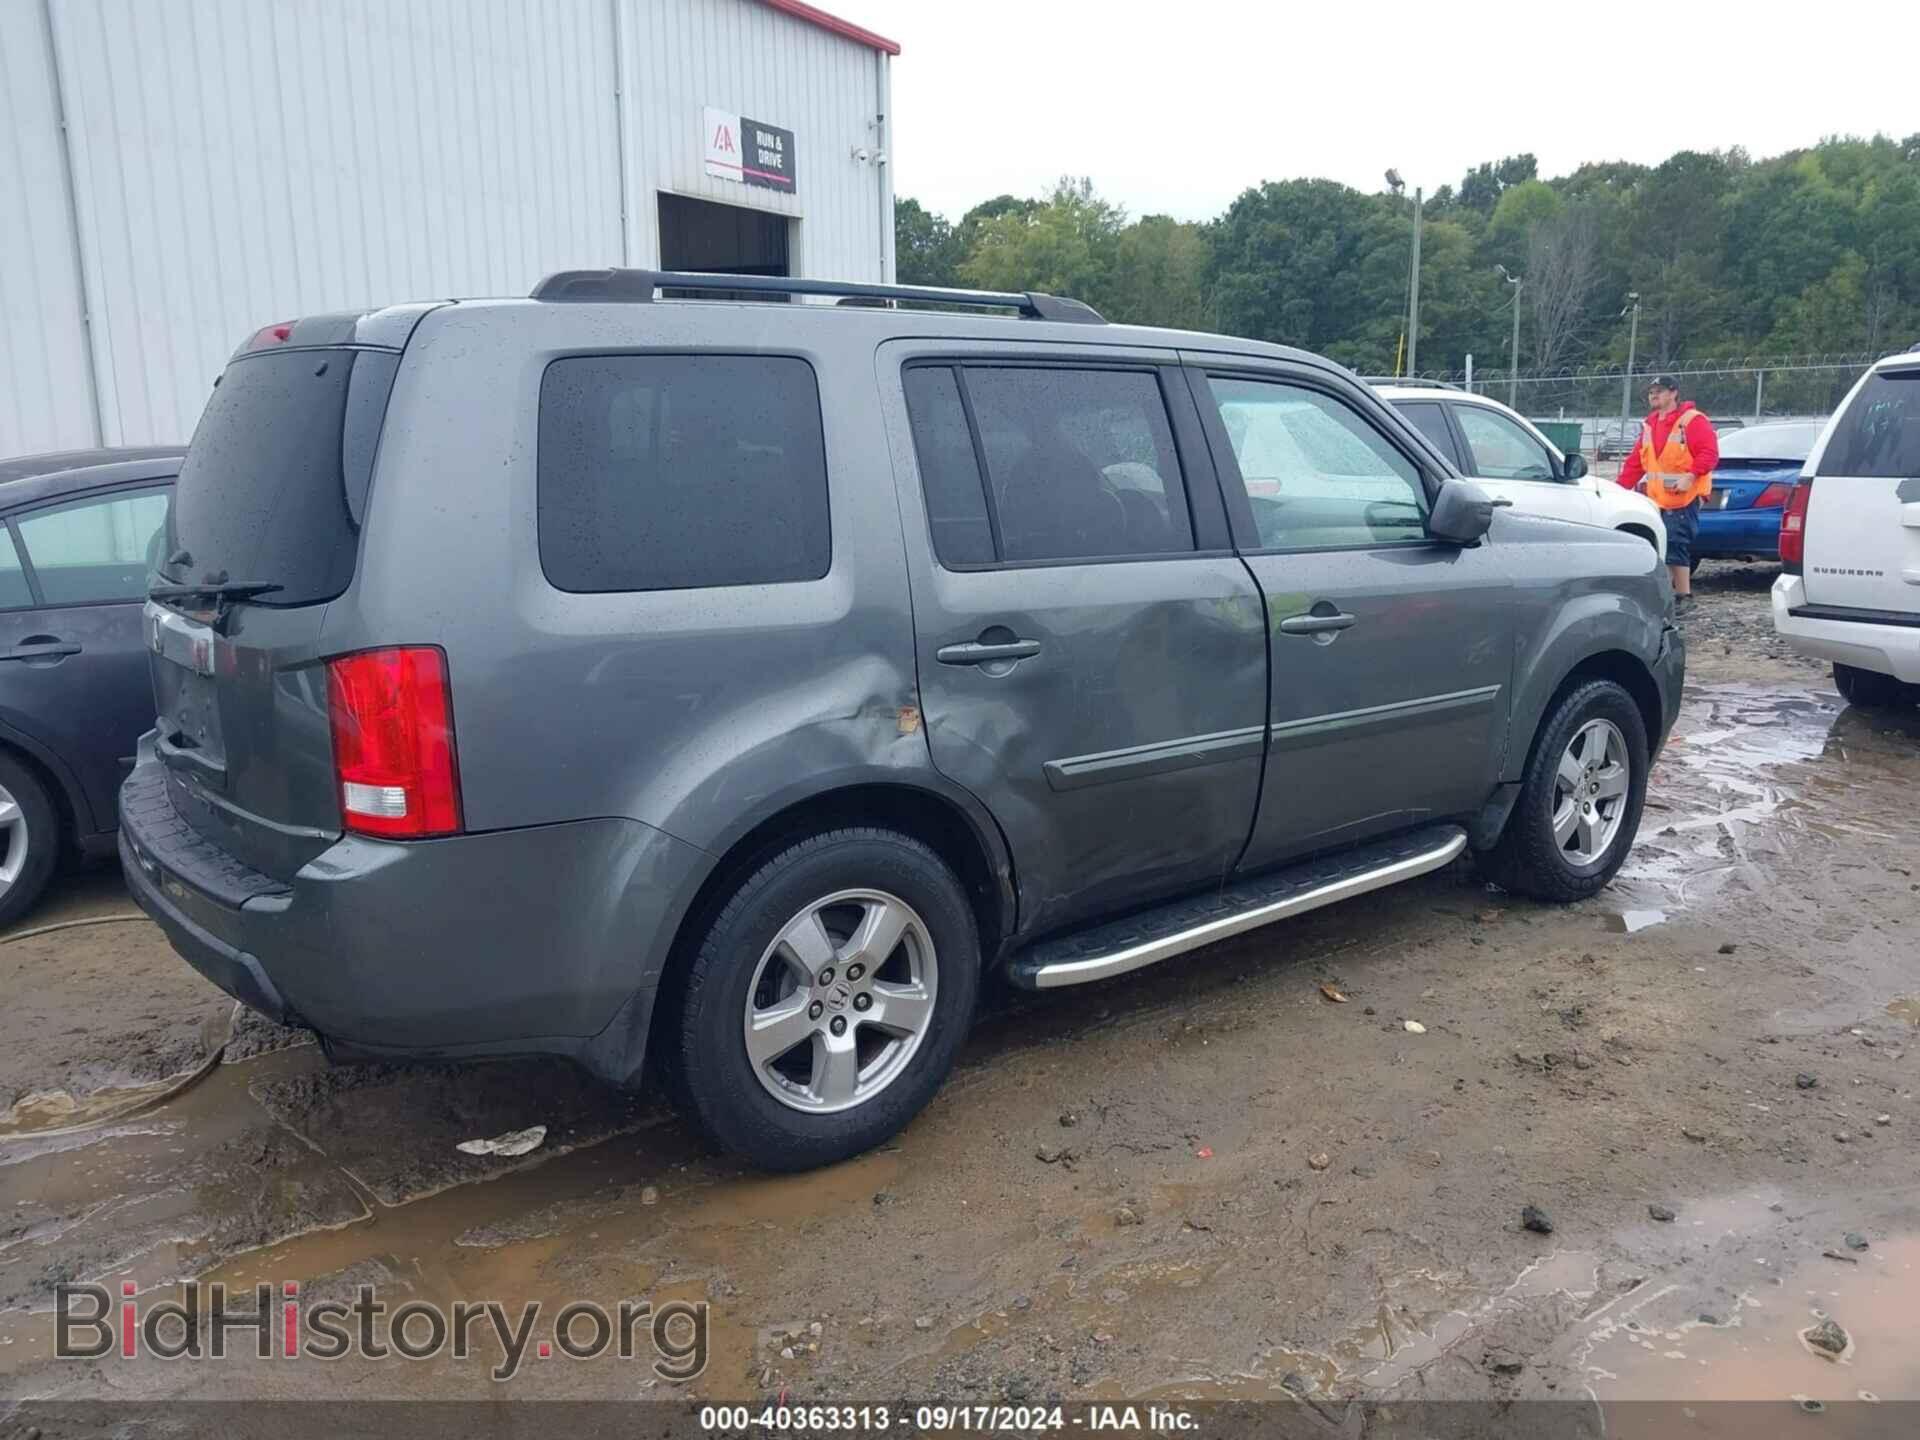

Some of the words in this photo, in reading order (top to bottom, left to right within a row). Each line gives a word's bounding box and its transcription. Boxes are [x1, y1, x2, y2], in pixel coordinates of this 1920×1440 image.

[756, 130, 774, 148] RUN
[775, 136, 783, 151] &
[758, 148, 783, 169] DRIVE
[1813, 566, 1884, 577] SUBURBAN
